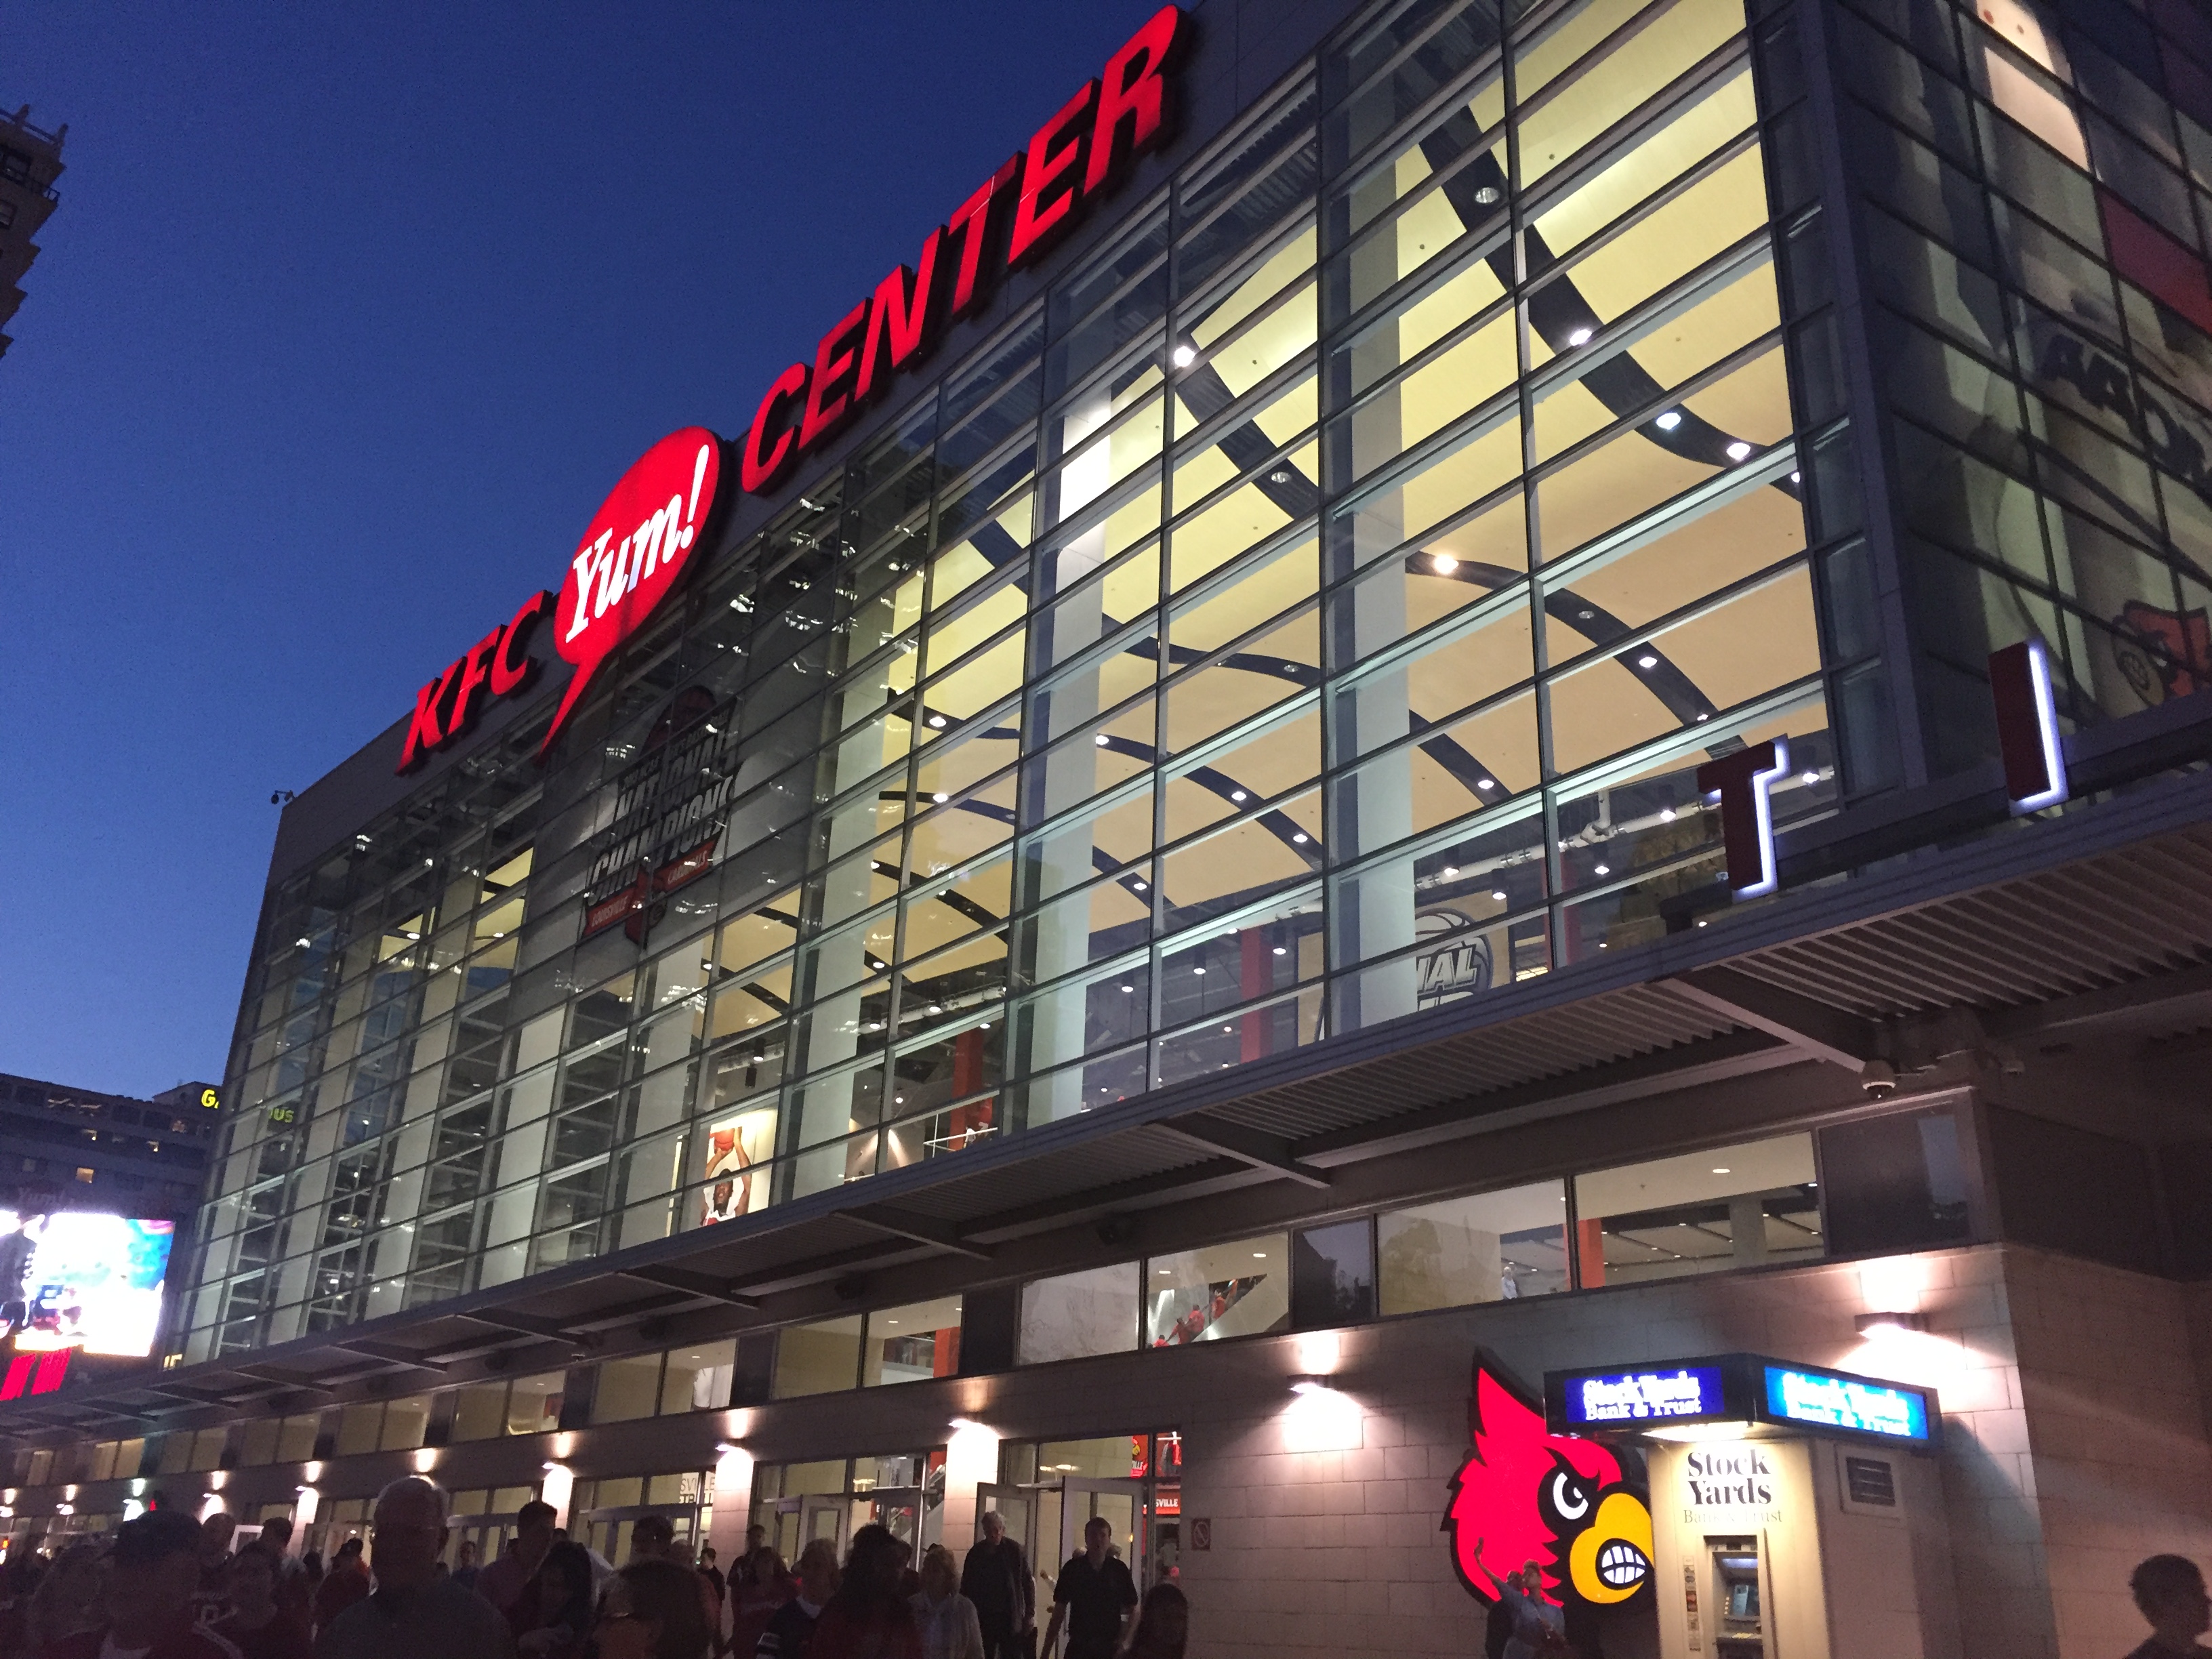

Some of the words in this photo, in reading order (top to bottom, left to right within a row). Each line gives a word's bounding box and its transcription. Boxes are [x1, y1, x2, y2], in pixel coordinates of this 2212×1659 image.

[395, 590, 546, 775] KFC
[566, 444, 709, 643] Yum!
[742, 5, 1181, 493] CENTER
[609, 728, 726, 846] NATONAL
[201, 1088, 219, 1109] G
[1585, 1401, 1631, 1420] Bank
[1650, 1399, 1702, 1416] Trust
[1687, 1449, 1771, 1477] Stock
[1687, 1478, 1772, 1504] Yards
[1683, 1509, 1720, 1523] Bank
[1744, 1509, 1783, 1522] Trust
